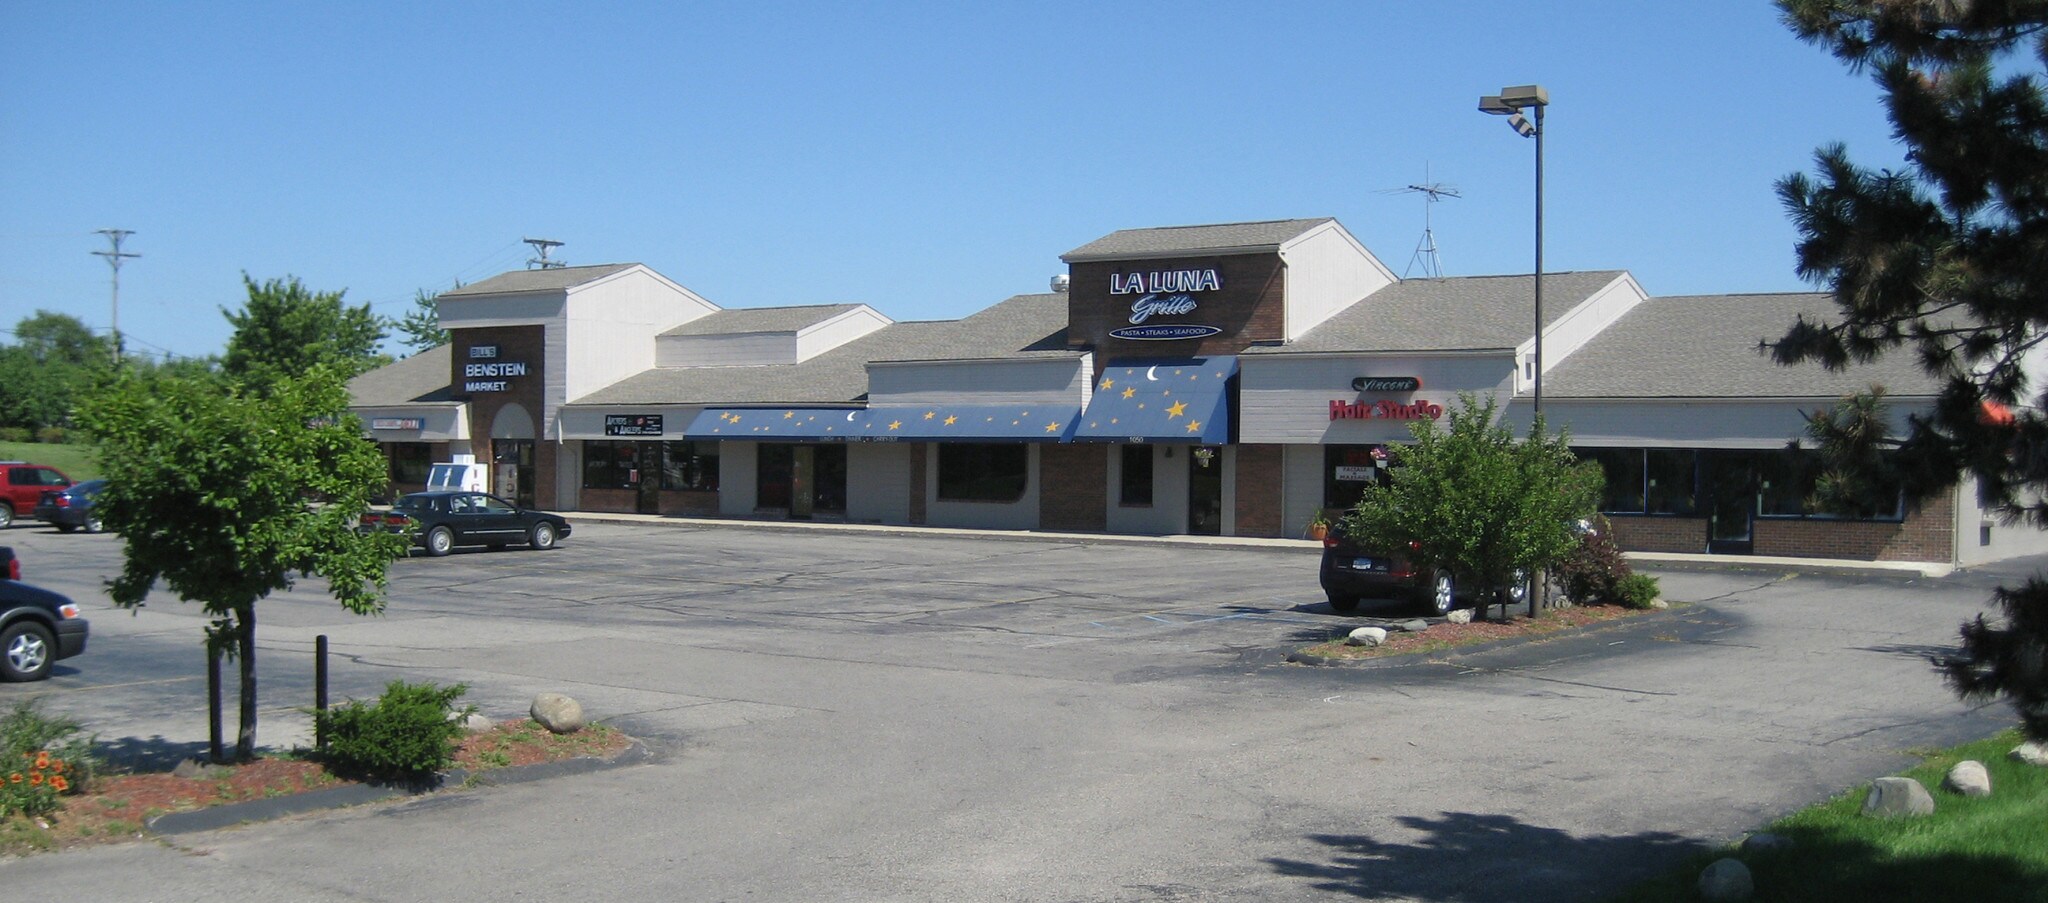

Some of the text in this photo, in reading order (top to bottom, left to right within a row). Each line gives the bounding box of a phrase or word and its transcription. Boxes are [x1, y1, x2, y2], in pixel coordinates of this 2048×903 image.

[1110, 269, 1220, 295] LA LUNA
[1128, 294, 1198, 325] Grille
[465, 362, 526, 377] BENSTEIN
[465, 381, 507, 392] MARKET
[1329, 400, 1443, 420] Hair Studio
